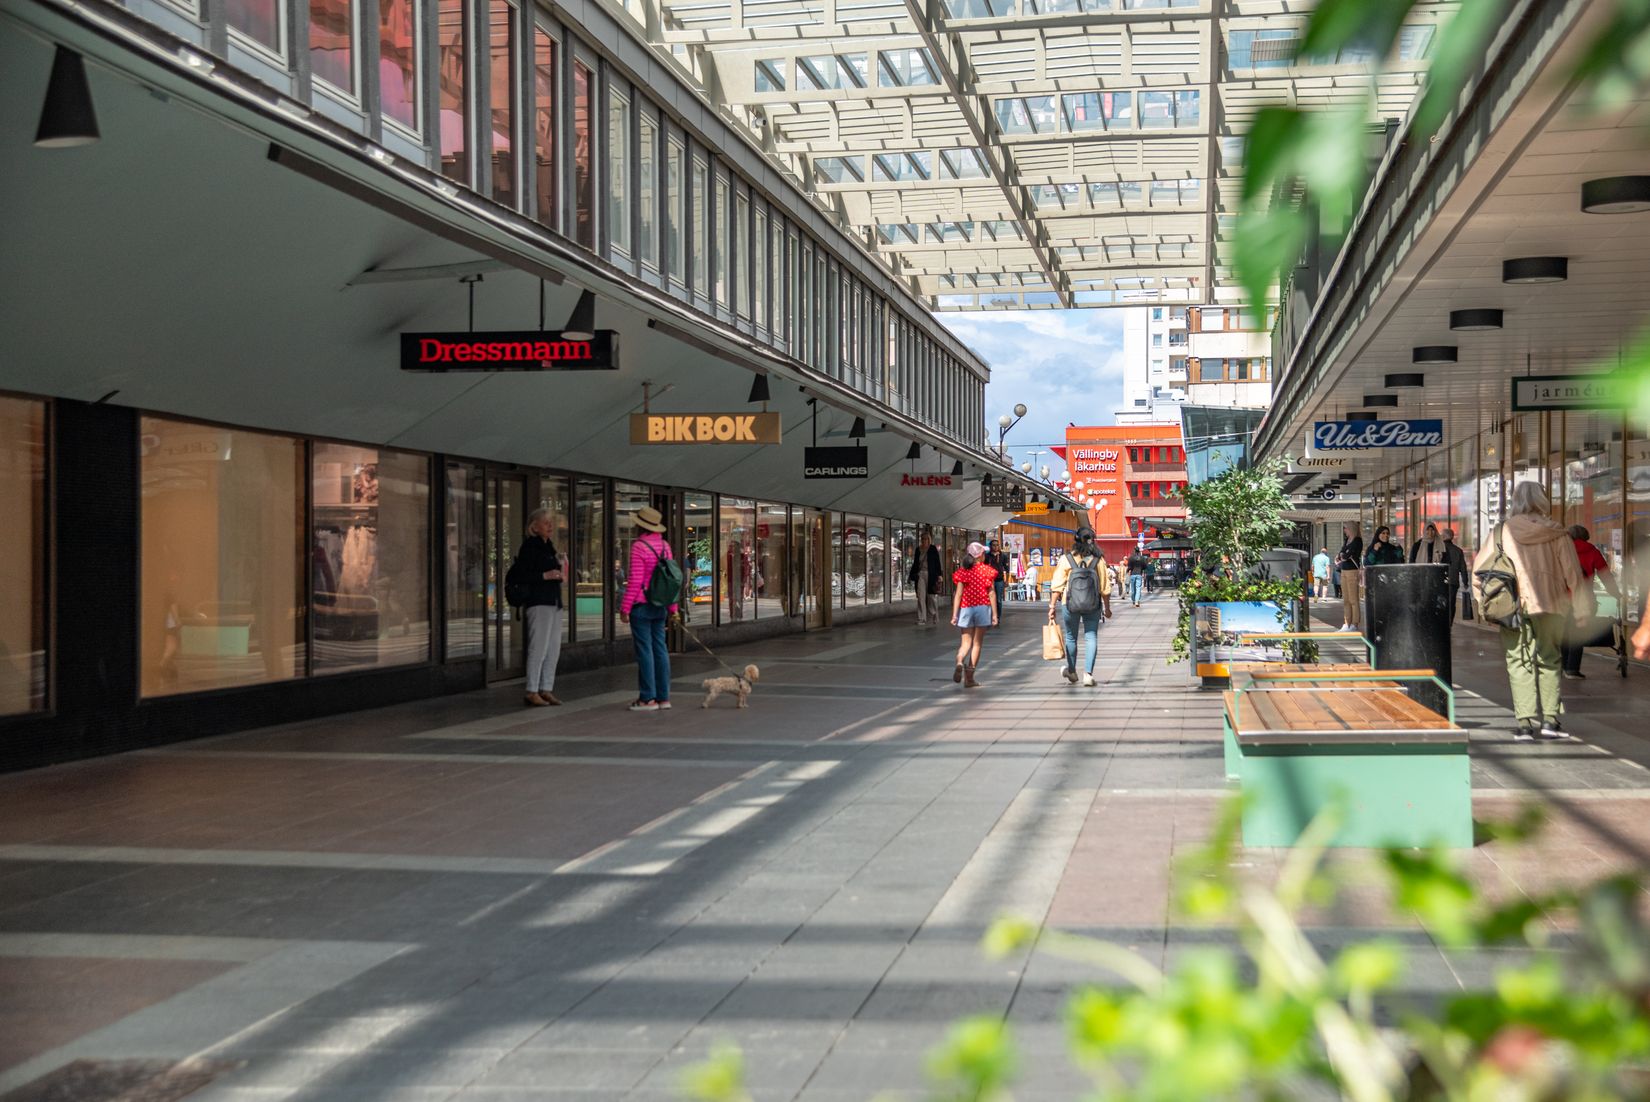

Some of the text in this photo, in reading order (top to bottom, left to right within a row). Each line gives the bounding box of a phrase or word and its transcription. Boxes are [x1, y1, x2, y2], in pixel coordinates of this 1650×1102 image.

[419, 339, 592, 362] Dressmann
[1072, 449, 1118, 460] Vällingby
[805, 467, 867, 475] CARLINGS
[1074, 461, 1116, 471] läkarhus
[901, 473, 951, 486] ÅHLÉNS
